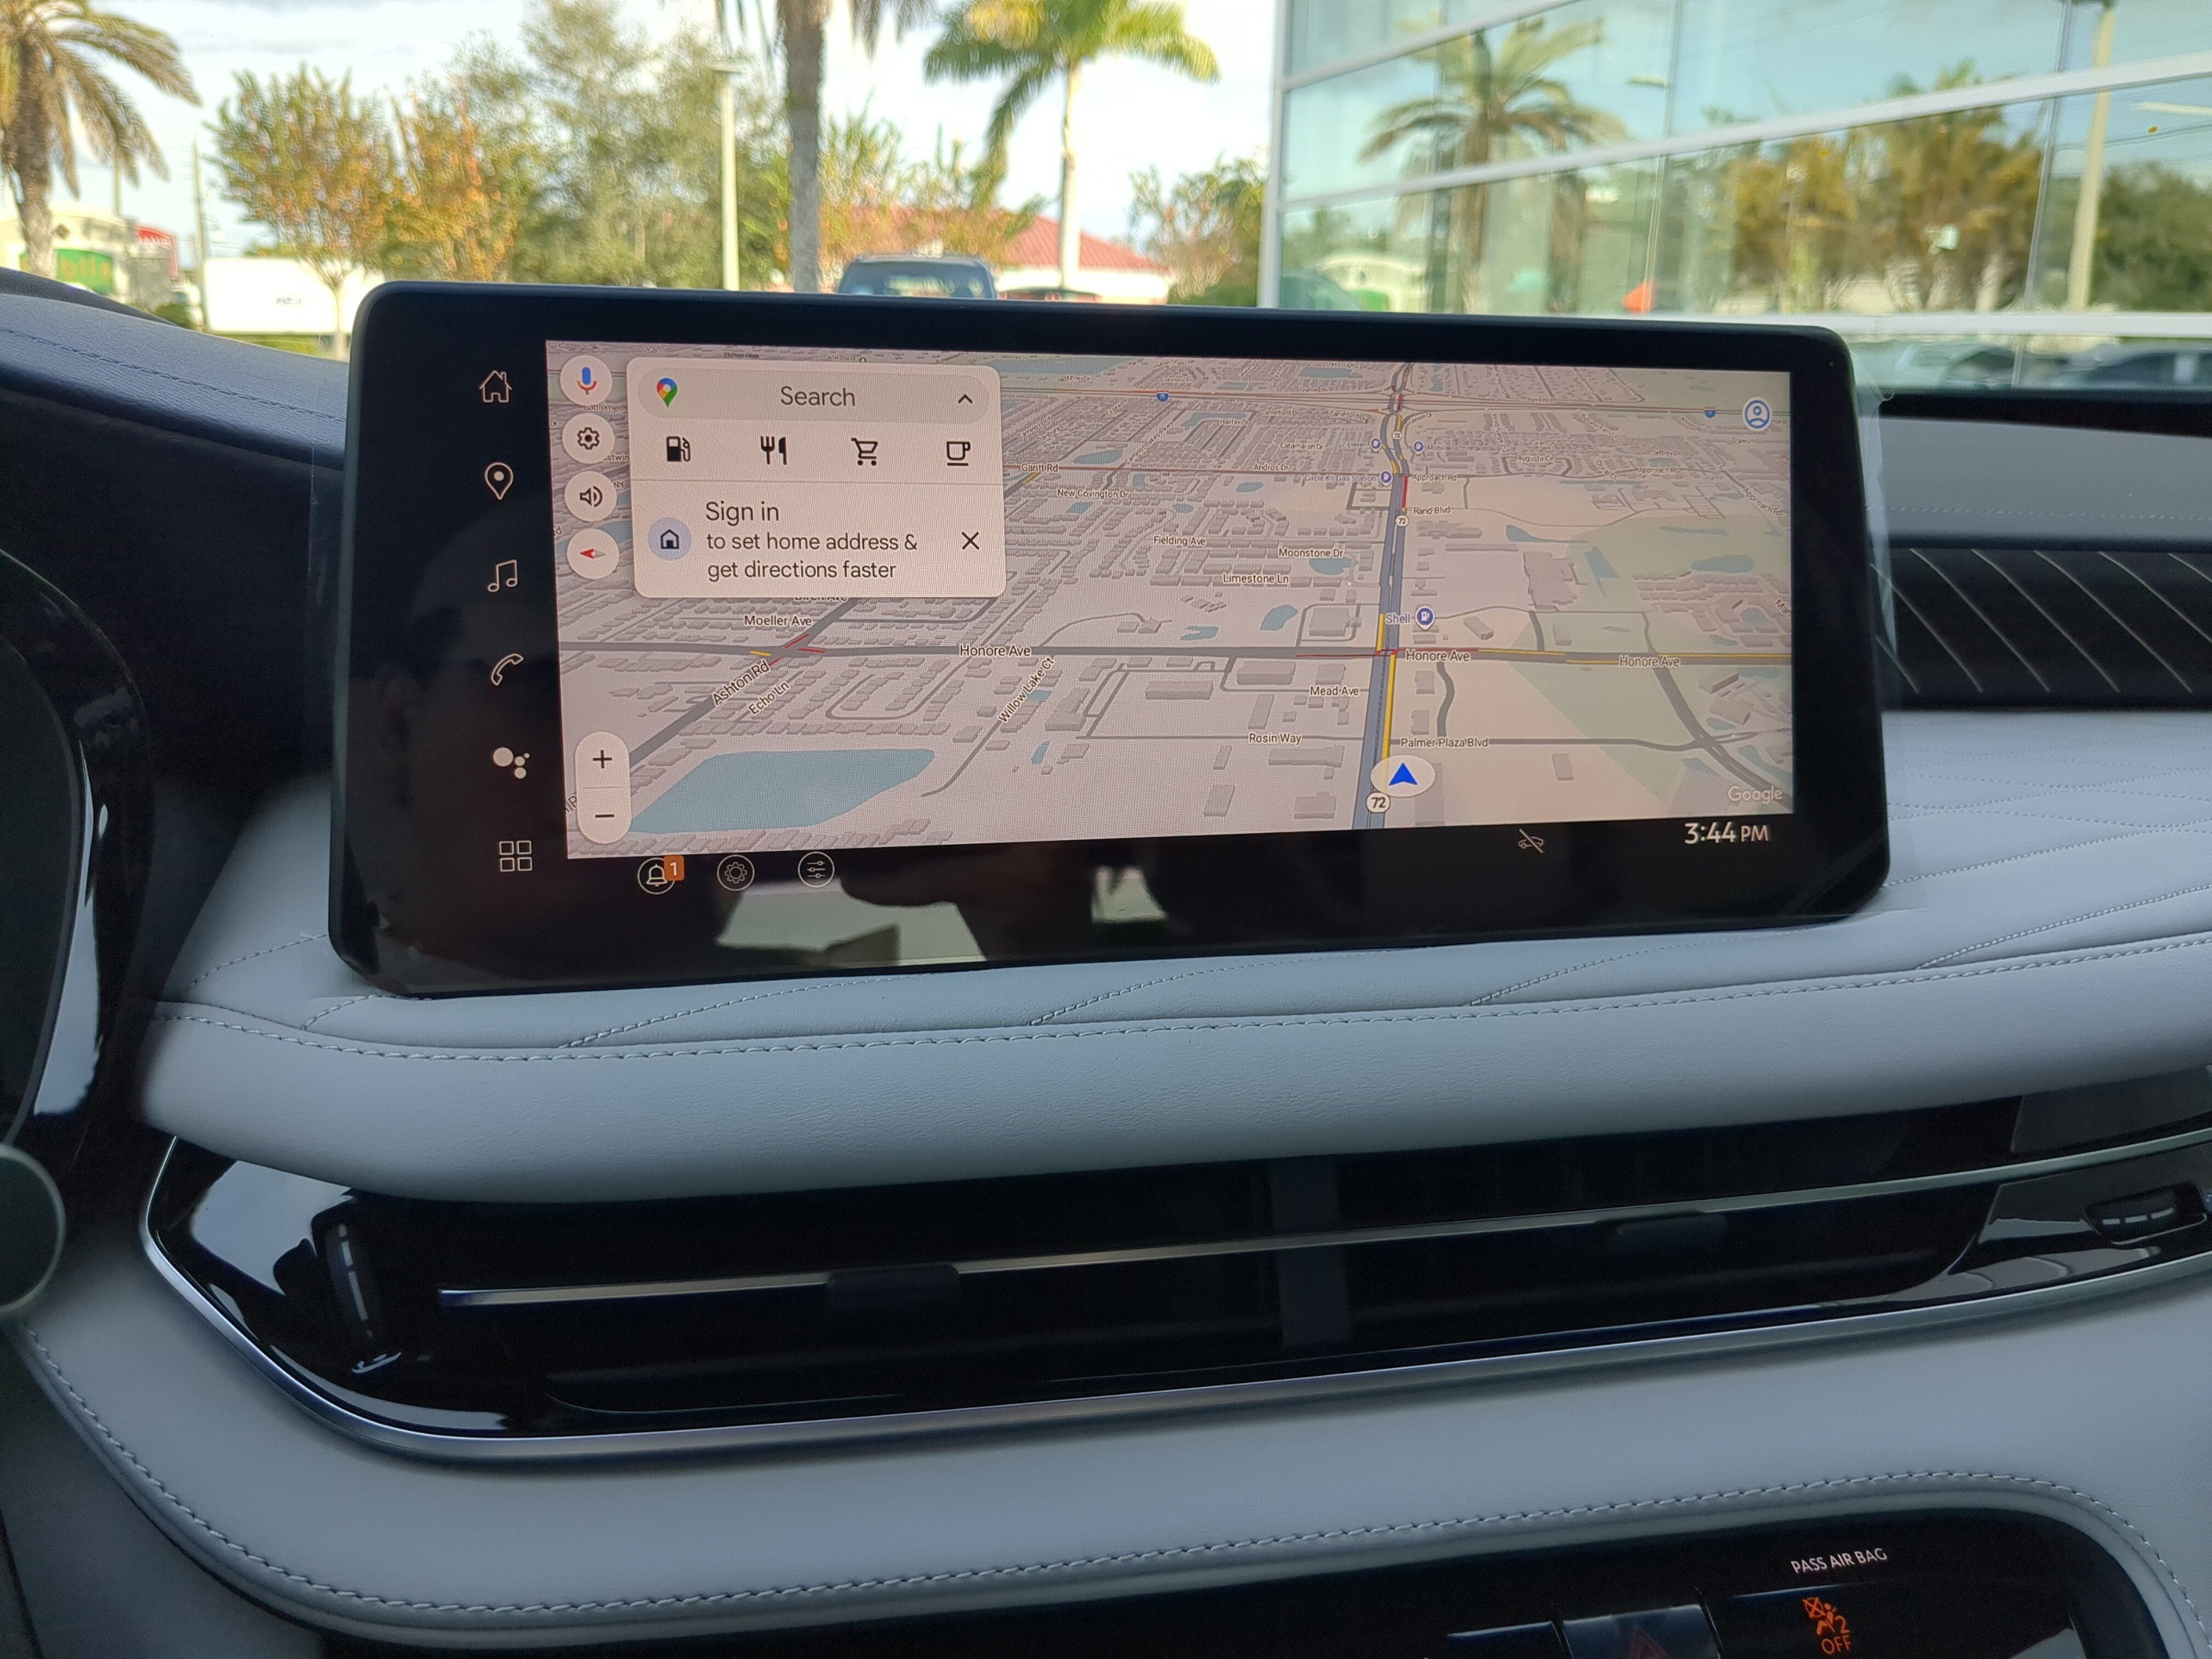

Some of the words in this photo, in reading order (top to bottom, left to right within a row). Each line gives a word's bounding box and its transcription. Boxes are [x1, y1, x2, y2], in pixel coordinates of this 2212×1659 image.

[781, 386, 856, 407] Search
[1125, 444, 1147, 466] Camelot
[1022, 463, 1046, 472] Gantt
[1047, 464, 1058, 472] Rd
[1057, 489, 1075, 498] New
[1077, 489, 1118, 499] Covington
[1743, 488, 1775, 513] Approach
[706, 500, 754, 527] Sign
[760, 500, 780, 522] in
[1434, 506, 1451, 514] Blvd
[707, 533, 726, 550] to
[731, 533, 760, 550] set
[767, 531, 820, 550] home
[826, 532, 899, 550] address
[904, 533, 918, 550] &
[1154, 535, 1188, 547] Fielding
[1190, 537, 1206, 546] Ave
[1278, 548, 1331, 558] Moonstone
[1333, 549, 1344, 558] Dr
[707, 561, 738, 583] get
[744, 560, 838, 578] directions
[842, 560, 897, 578] faster
[1223, 574, 1274, 583] Limestone
[1277, 574, 1289, 584] Ln
[744, 615, 788, 627] Moeller
[791, 616, 812, 627] Ave
[1385, 614, 1411, 624] Shell
[960, 644, 1006, 657] Honore
[1008, 645, 1031, 657] Ave
[1406, 650, 1447, 662] Honore
[1449, 651, 1470, 662] Ave
[1619, 656, 1659, 667] Honore
[1660, 656, 1680, 668] Ave
[713, 671, 753, 706] Ashton
[751, 659, 770, 678] Rd
[998, 690, 1028, 723] Willow
[1023, 669, 1046, 693] Lake
[1041, 657, 1054, 670] Ct
[1310, 686, 1339, 696] Mead
[1341, 686, 1360, 696] Ave
[748, 692, 776, 714] Echo
[773, 681, 790, 696] Ln
[1249, 733, 1278, 743] Rosin
[1279, 734, 1302, 746] Way
[1401, 737, 1437, 748] Palmer
[1438, 738, 1465, 748] Plaza
[1467, 737, 1489, 748] Blvd
[1728, 785, 1783, 805] Google
[1371, 797, 1387, 809] 72
[1684, 821, 1737, 845] 3:44
[1740, 824, 1769, 843] PM
[669, 862, 678, 876] 1
[1790, 1556, 1828, 1575] PASS
[1830, 1553, 1855, 1568] AIR
[1854, 1548, 1888, 1564] BAG
[1835, 1615, 1850, 1634] 2
[1821, 1635, 1852, 1654] OFF
